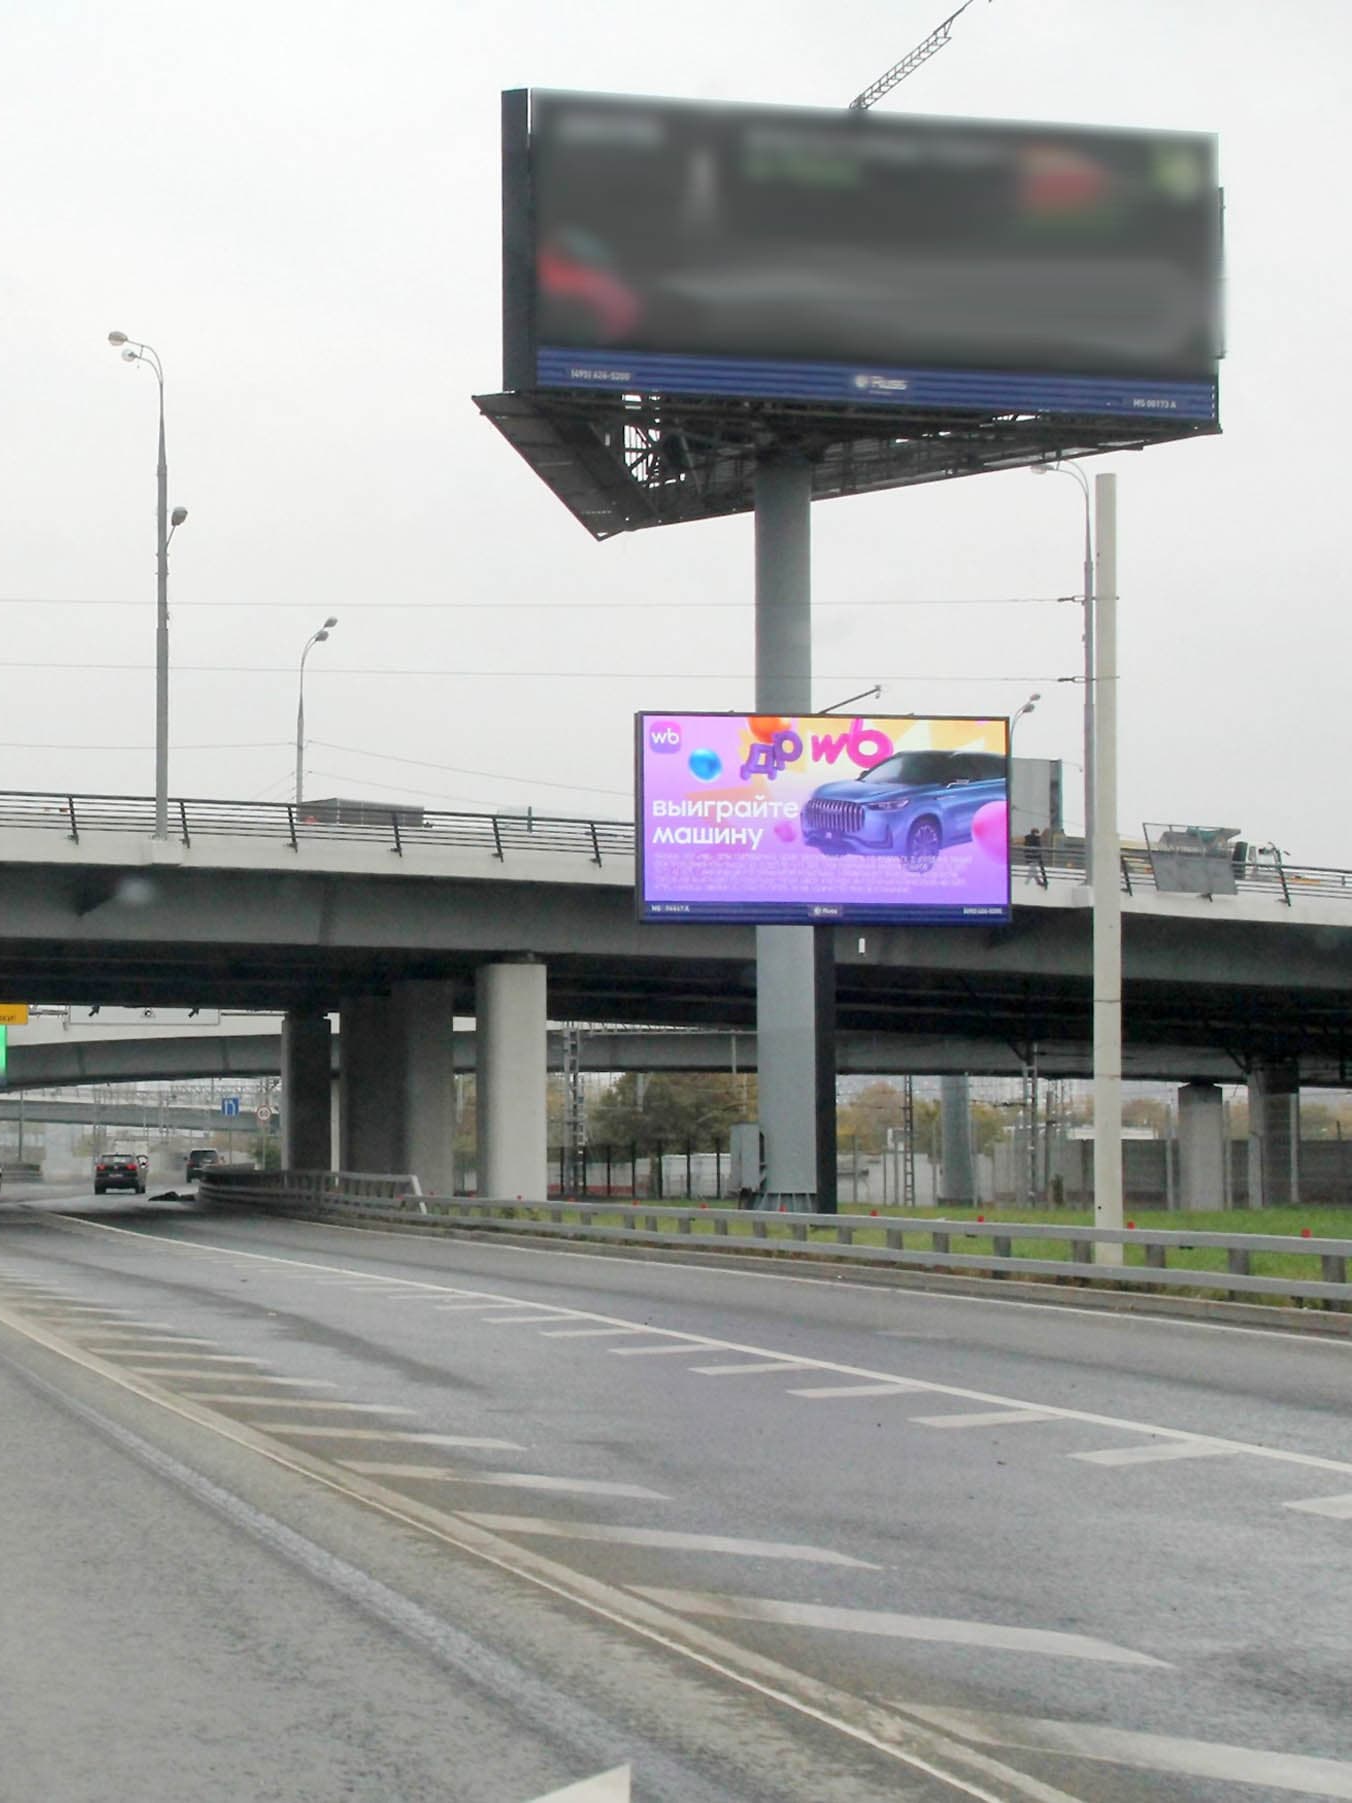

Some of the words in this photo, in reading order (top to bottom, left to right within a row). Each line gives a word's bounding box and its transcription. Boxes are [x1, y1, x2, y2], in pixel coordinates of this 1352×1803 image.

[651, 728, 680, 745] wb
[652, 795, 799, 822] выиграйте
[652, 826, 765, 850] машину
